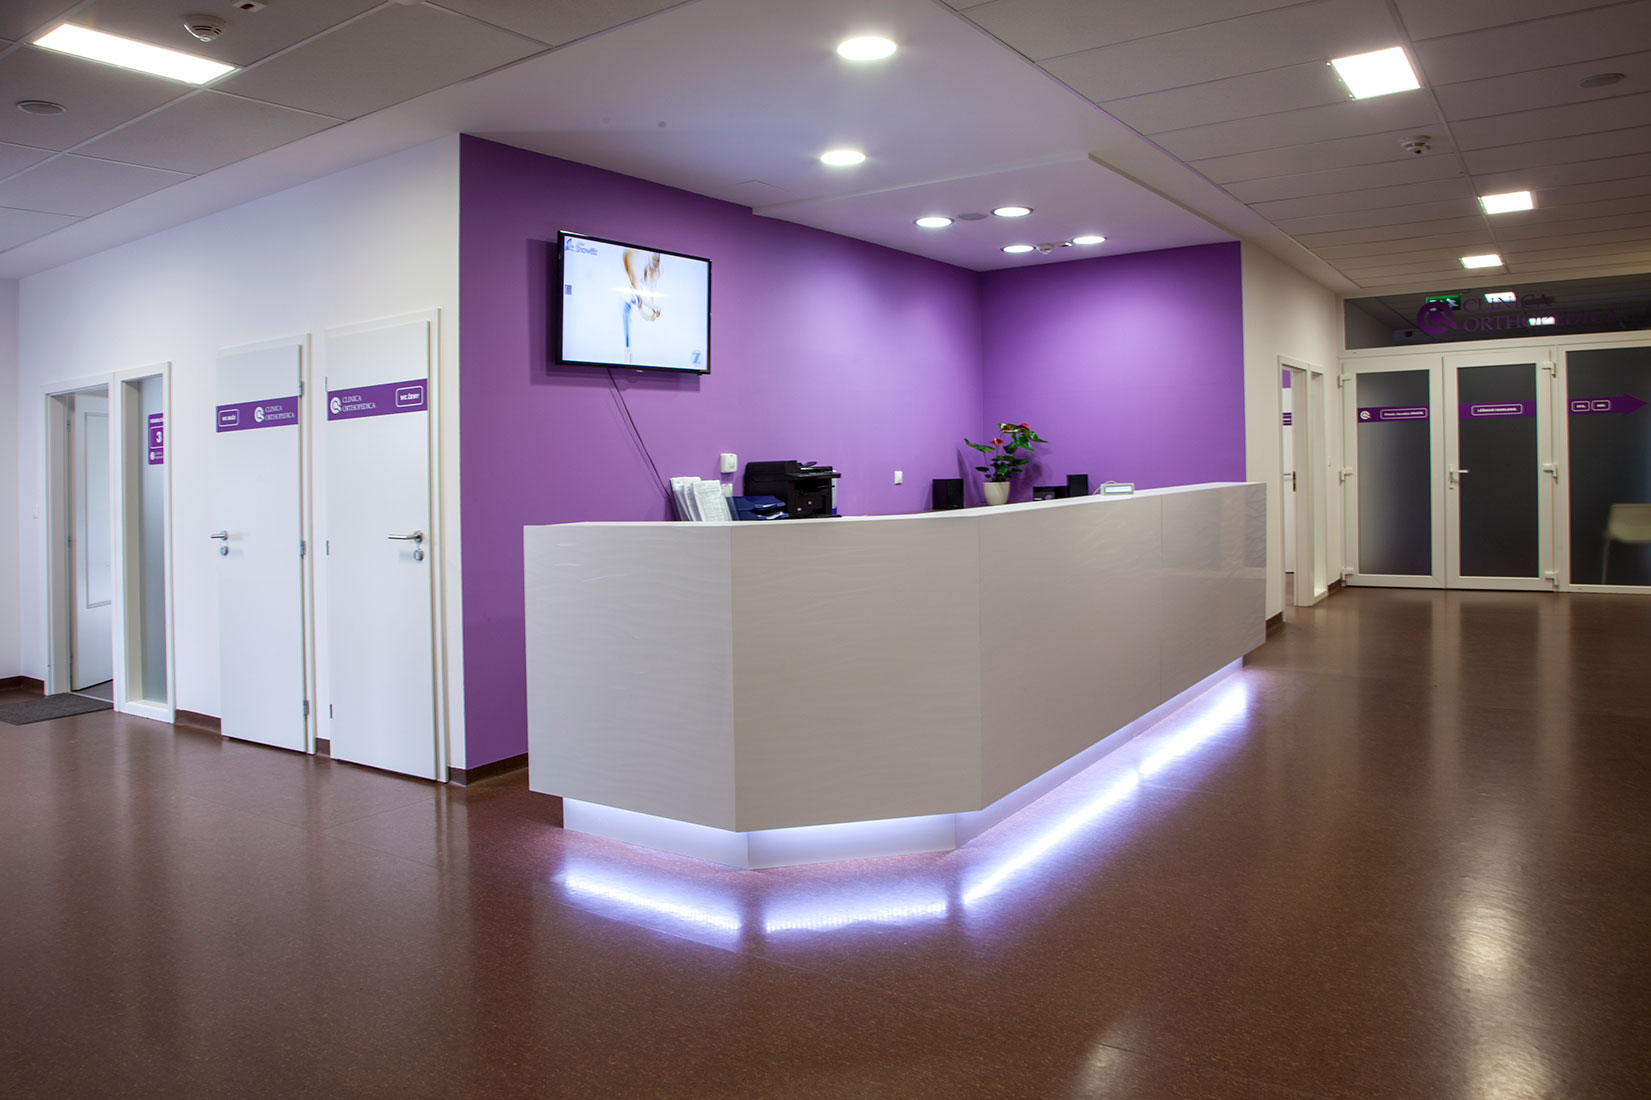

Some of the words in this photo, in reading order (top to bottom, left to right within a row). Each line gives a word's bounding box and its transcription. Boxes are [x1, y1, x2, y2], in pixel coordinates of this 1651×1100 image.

[1463, 293, 1550, 313] CLINICA
[341, 395, 362, 403] CLINICA
[264, 405, 283, 413] CLINICA
[341, 402, 377, 412] ORTHOPEDICA
[264, 412, 295, 421] ORTHOPEDICA
[156, 431, 162, 443] 3
